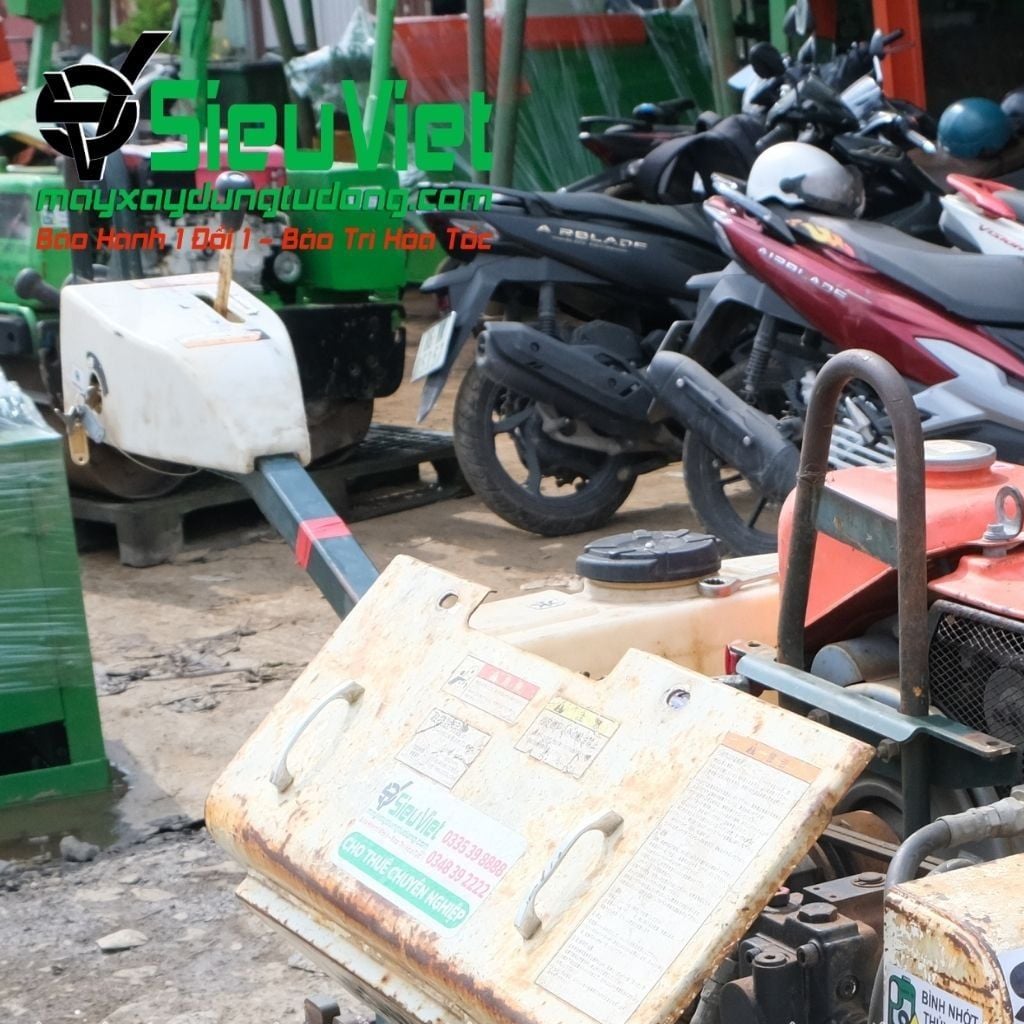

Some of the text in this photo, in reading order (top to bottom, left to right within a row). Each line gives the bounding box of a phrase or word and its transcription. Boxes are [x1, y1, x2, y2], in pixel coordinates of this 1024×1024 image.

[388, 792, 447, 841] SieuViet
[425, 850, 491, 899] 0348 39 2222
[442, 830, 471, 859] 0335
[465, 844, 484, 866] 39
[478, 851, 509, 878] 8888
[342, 835, 364, 858] CHO
[362, 849, 395, 878] THUÊ
[386, 864, 430, 901] CHUYÊN
[425, 888, 467, 924] NGHIỆP
[922, 990, 945, 1014] BÌNH
